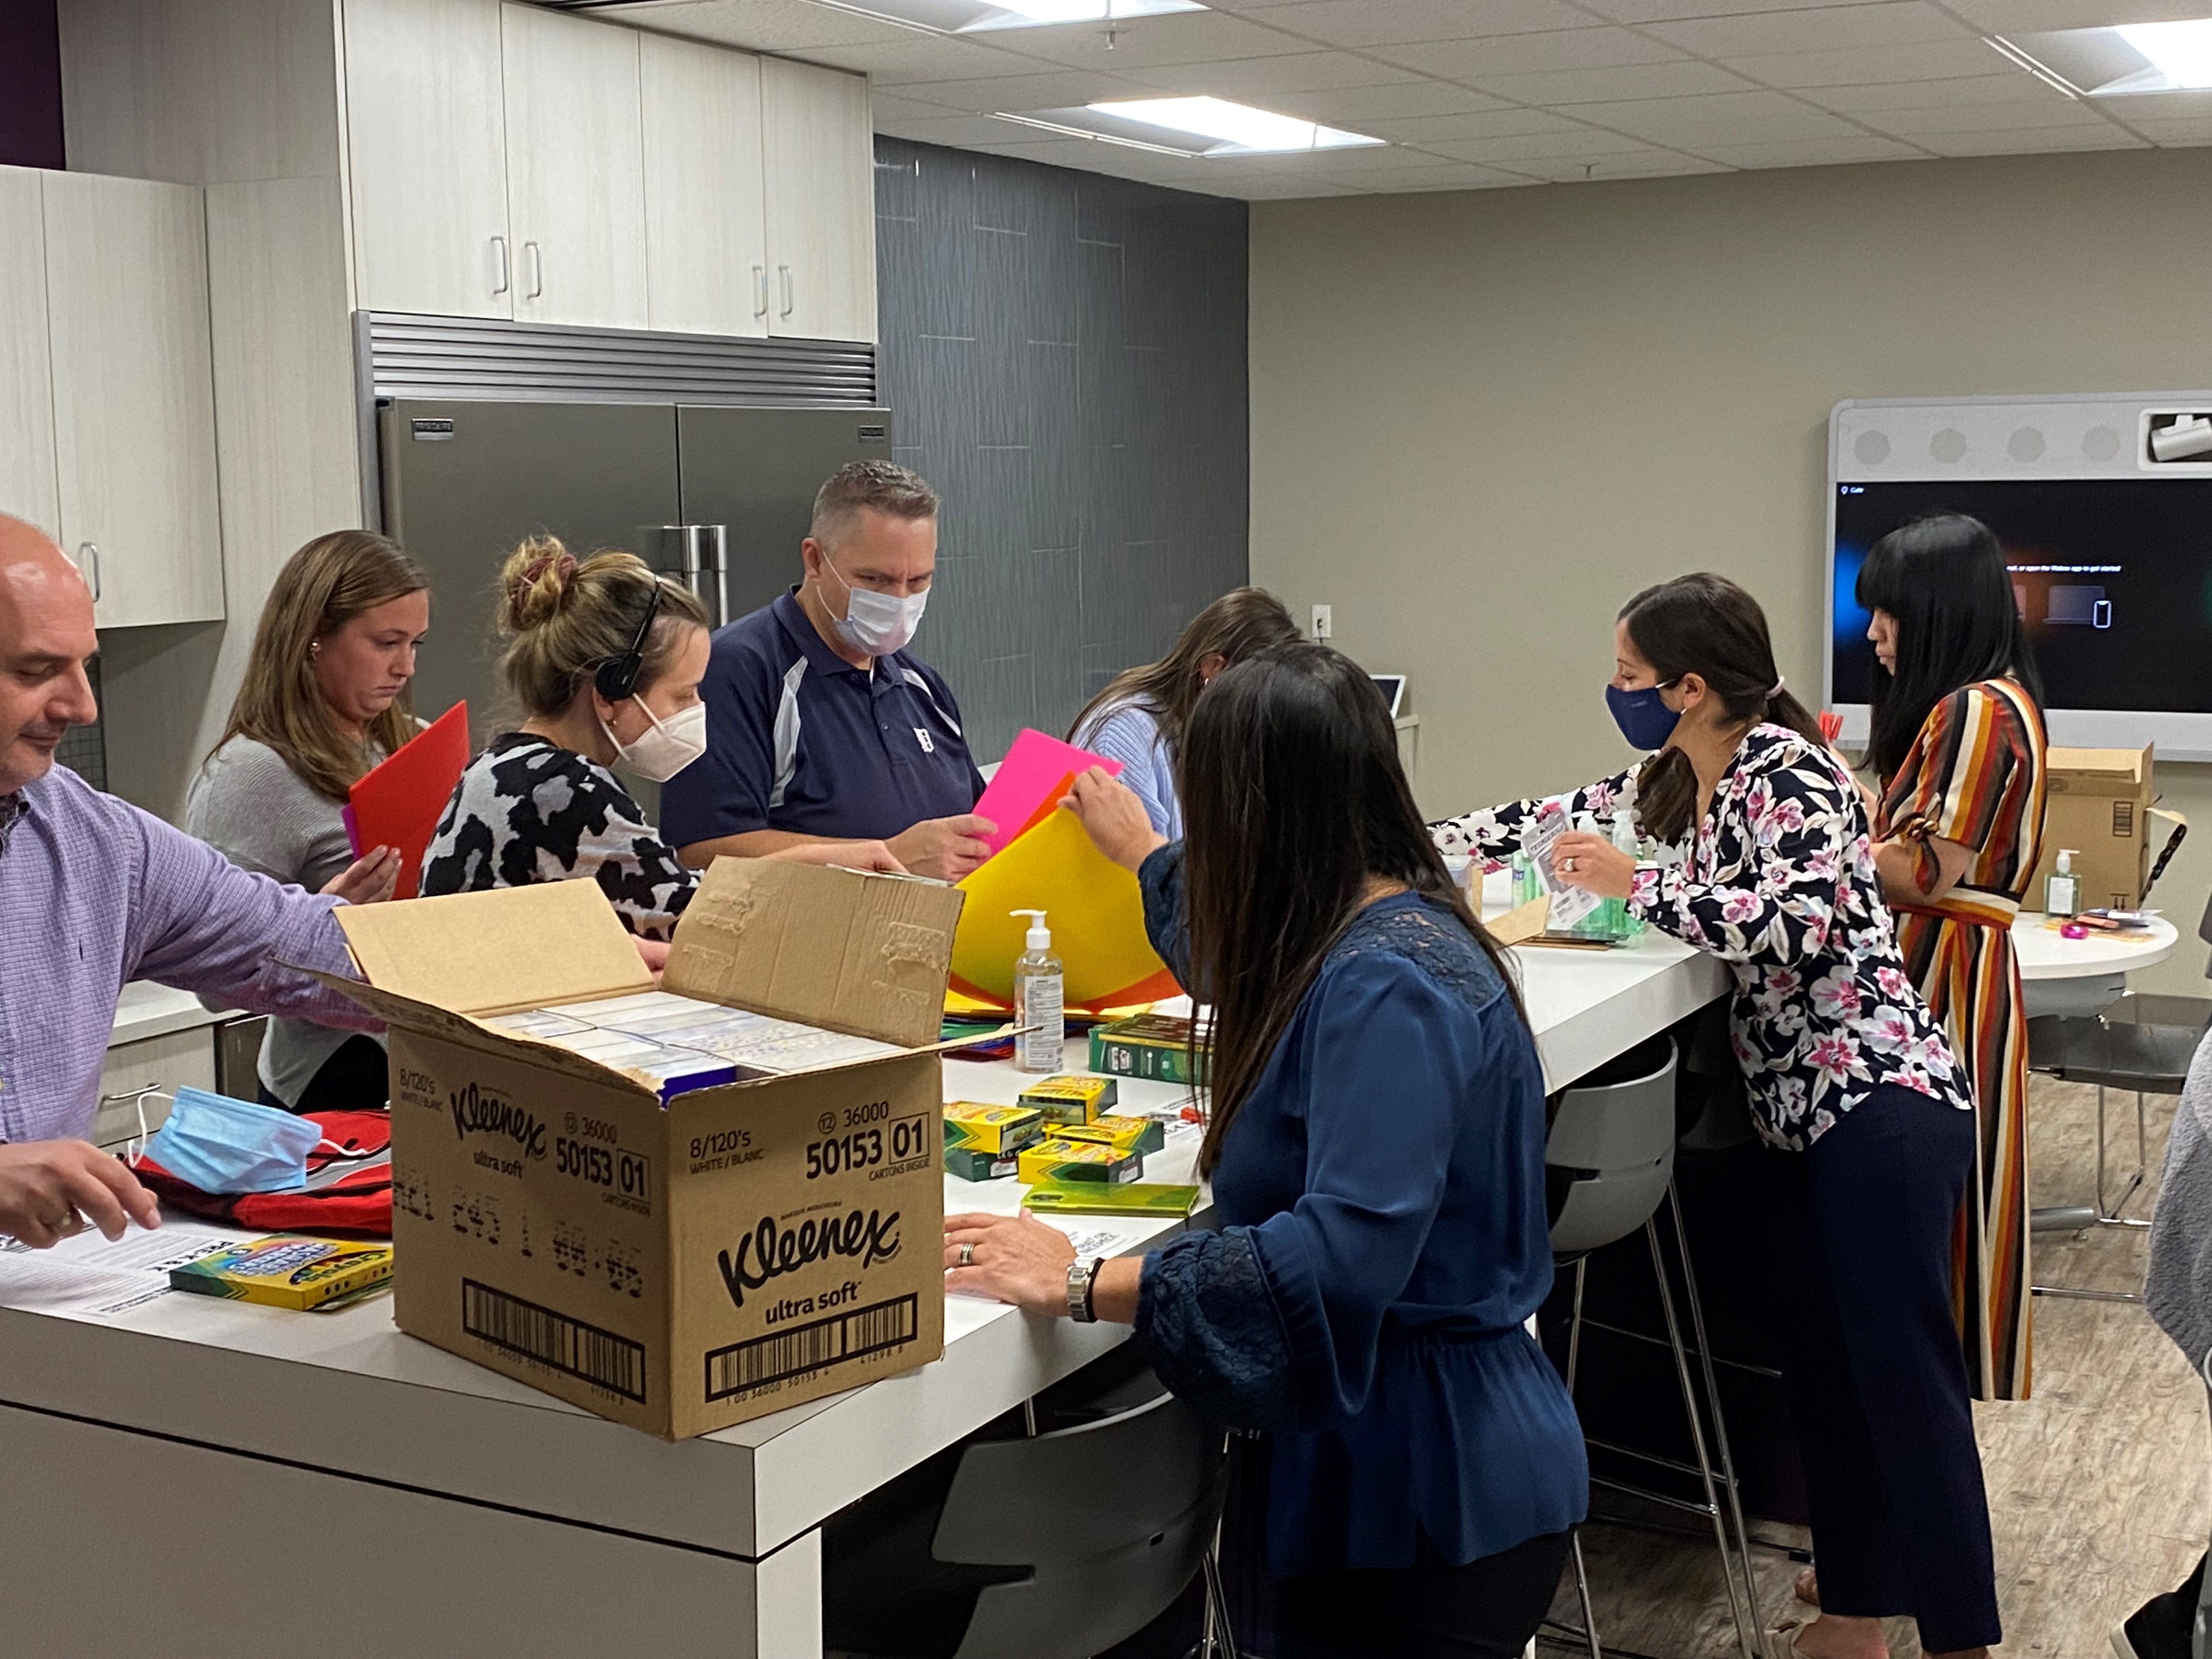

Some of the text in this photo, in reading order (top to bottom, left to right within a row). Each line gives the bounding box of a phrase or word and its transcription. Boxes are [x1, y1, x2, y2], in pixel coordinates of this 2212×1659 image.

[450, 1082, 546, 1159] Kleenex
[843, 1101, 889, 1128] 36000
[690, 1129, 751, 1159] 8/120's
[690, 1157, 723, 1175] WHITE
[806, 1118, 922, 1180] 50153 01
[556, 1136, 644, 1197] 50153 01
[869, 1164, 904, 1181] CARTONS
[718, 1209, 900, 1308] Kleenex
[765, 1280, 857, 1324] ultra soft
